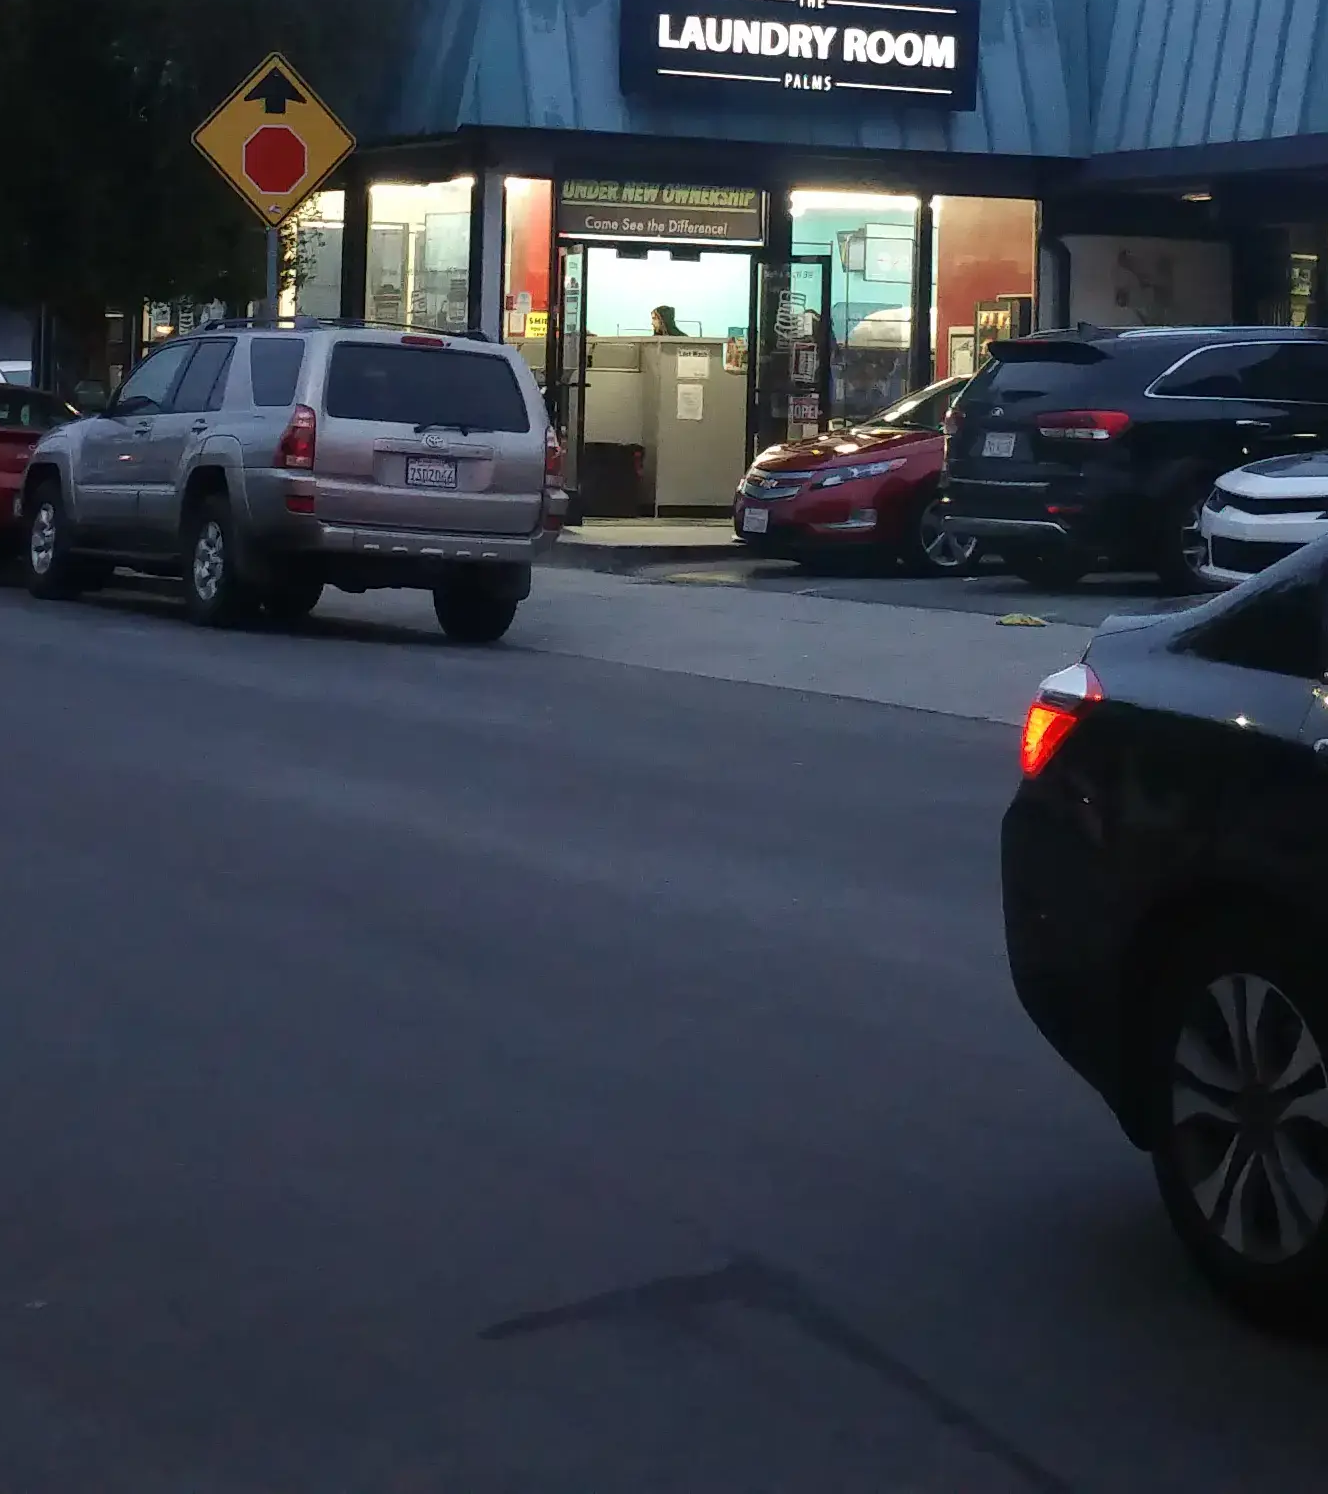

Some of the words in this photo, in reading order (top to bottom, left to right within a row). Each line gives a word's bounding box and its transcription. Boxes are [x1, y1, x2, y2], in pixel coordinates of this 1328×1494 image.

[657, 13, 837, 60] LAUNDRY
[843, 28, 955, 69] ROOM
[784, 72, 832, 92] PALMS
[562, 180, 620, 200] UNDER
[622, 182, 659, 204] NEW
[662, 184, 757, 207] OWNERSHIP
[584, 215, 619, 230] Come
[622, 217, 644, 232] See
[647, 217, 665, 233] the
